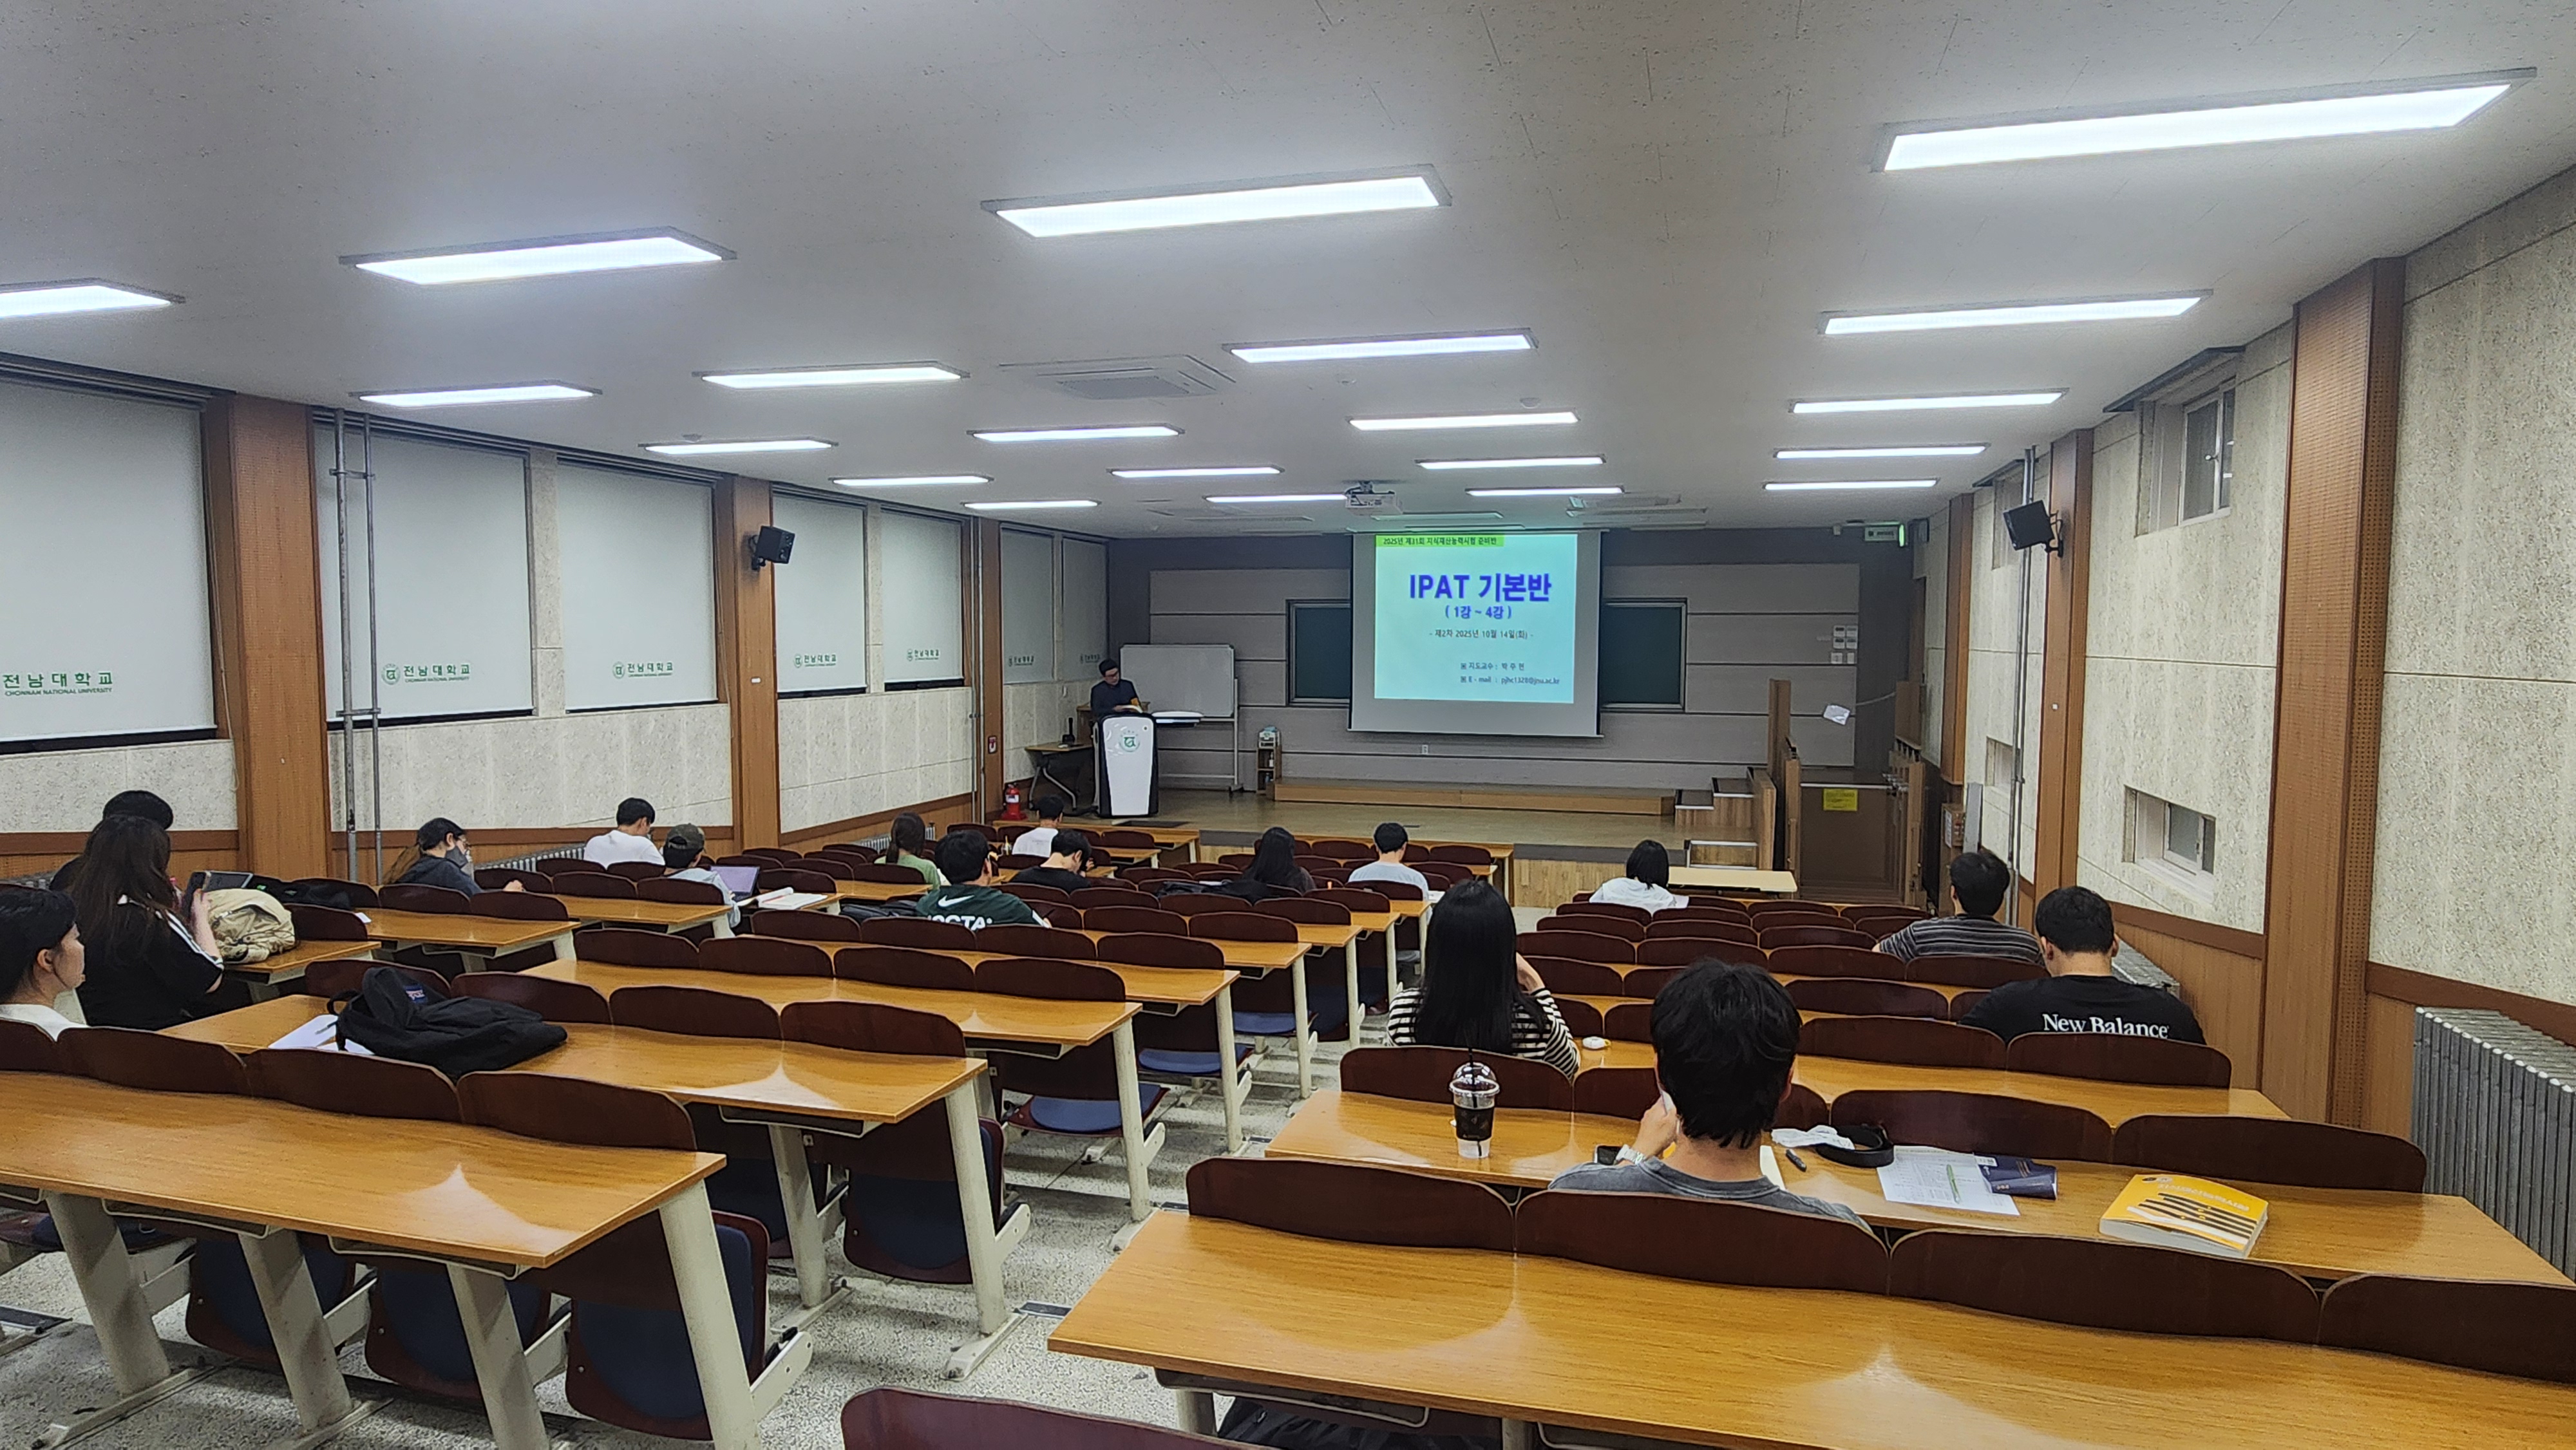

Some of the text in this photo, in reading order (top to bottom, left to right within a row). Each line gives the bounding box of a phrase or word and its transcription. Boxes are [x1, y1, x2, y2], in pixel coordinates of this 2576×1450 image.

[1410, 573, 1552, 603] IPAT 기본반
[1435, 629, 1453, 638] 제2차
[1455, 629, 1479, 639] 2025년
[1482, 630, 1497, 639] 10월
[1501, 630, 1528, 639] 14일(화)
[403, 664, 470, 677] 전남대학교
[3, 672, 113, 688] 전남대학교
[2042, 1013, 2168, 1039] New Balance
